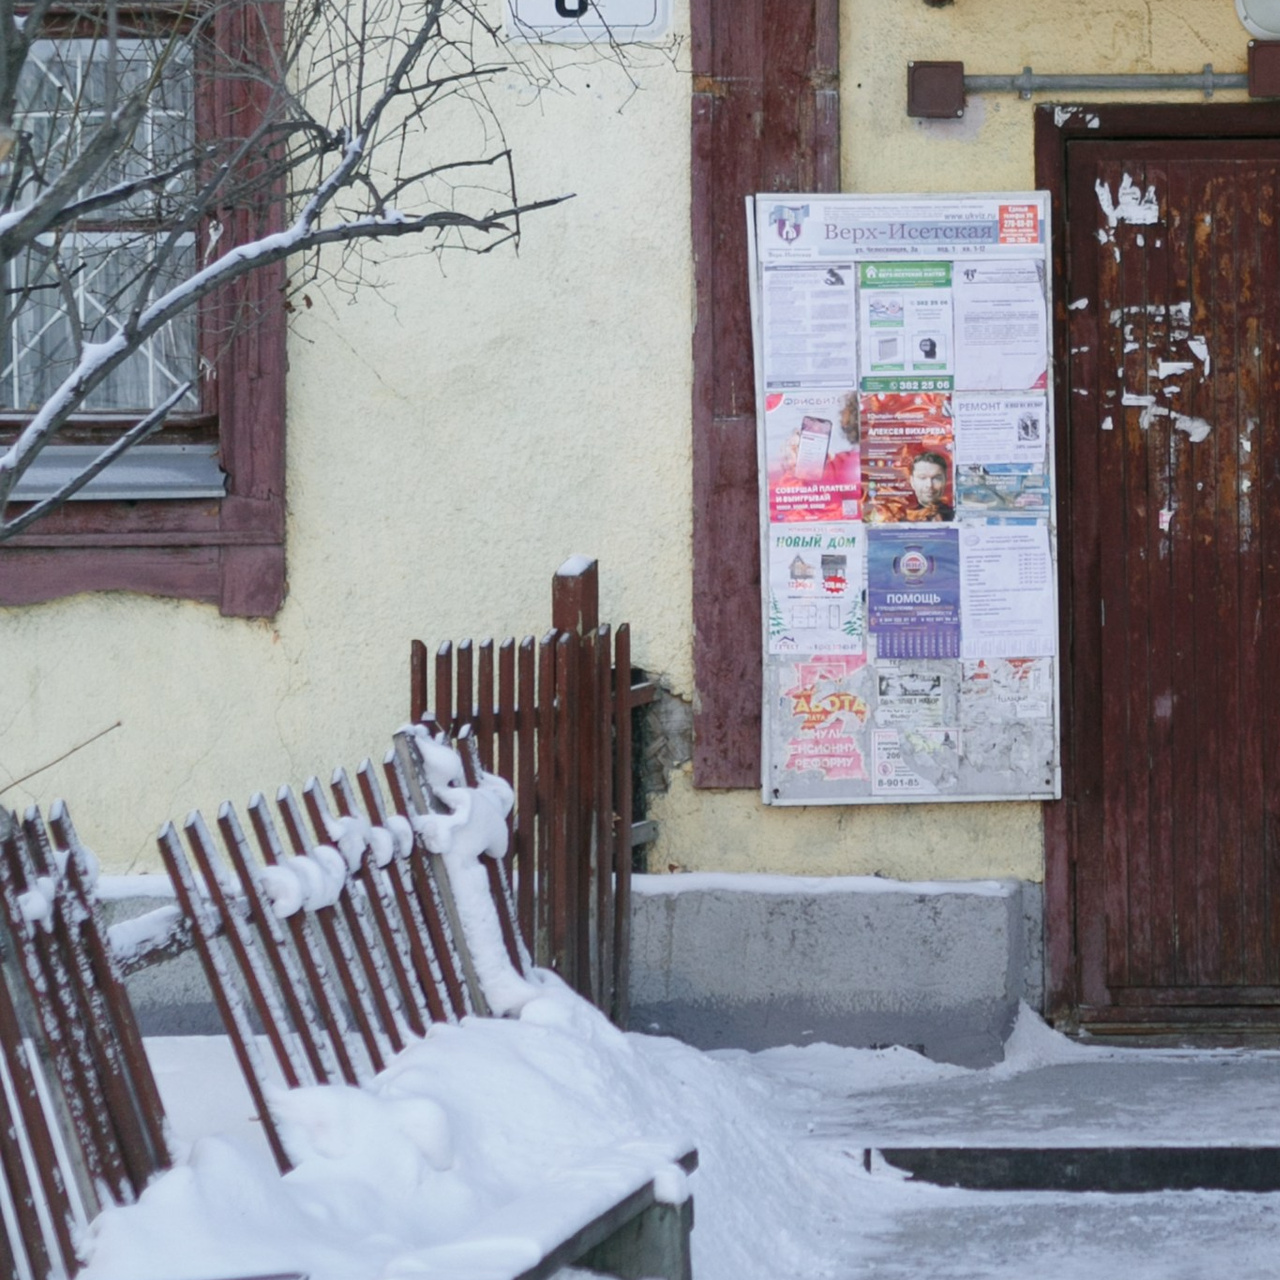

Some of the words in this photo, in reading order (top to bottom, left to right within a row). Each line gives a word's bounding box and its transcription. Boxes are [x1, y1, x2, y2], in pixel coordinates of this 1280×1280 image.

[824, 223, 993, 244] Верх-Исетская
[899, 381, 919, 390] 382
[921, 381, 935, 389] 25
[959, 402, 1001, 411] РЕМОНТ
[775, 484, 819, 494] СОВЕРШАЙ
[819, 484, 857, 492] ПЛАТЕЖИ
[783, 493, 831, 503] ВЫИГРЫВАЙ
[776, 534, 822, 548] НОВЫЙ
[826, 536, 856, 549] ДОМ
[886, 593, 941, 605] ПОМОЩЬ
[795, 756, 854, 768] РЕФОРМУ
